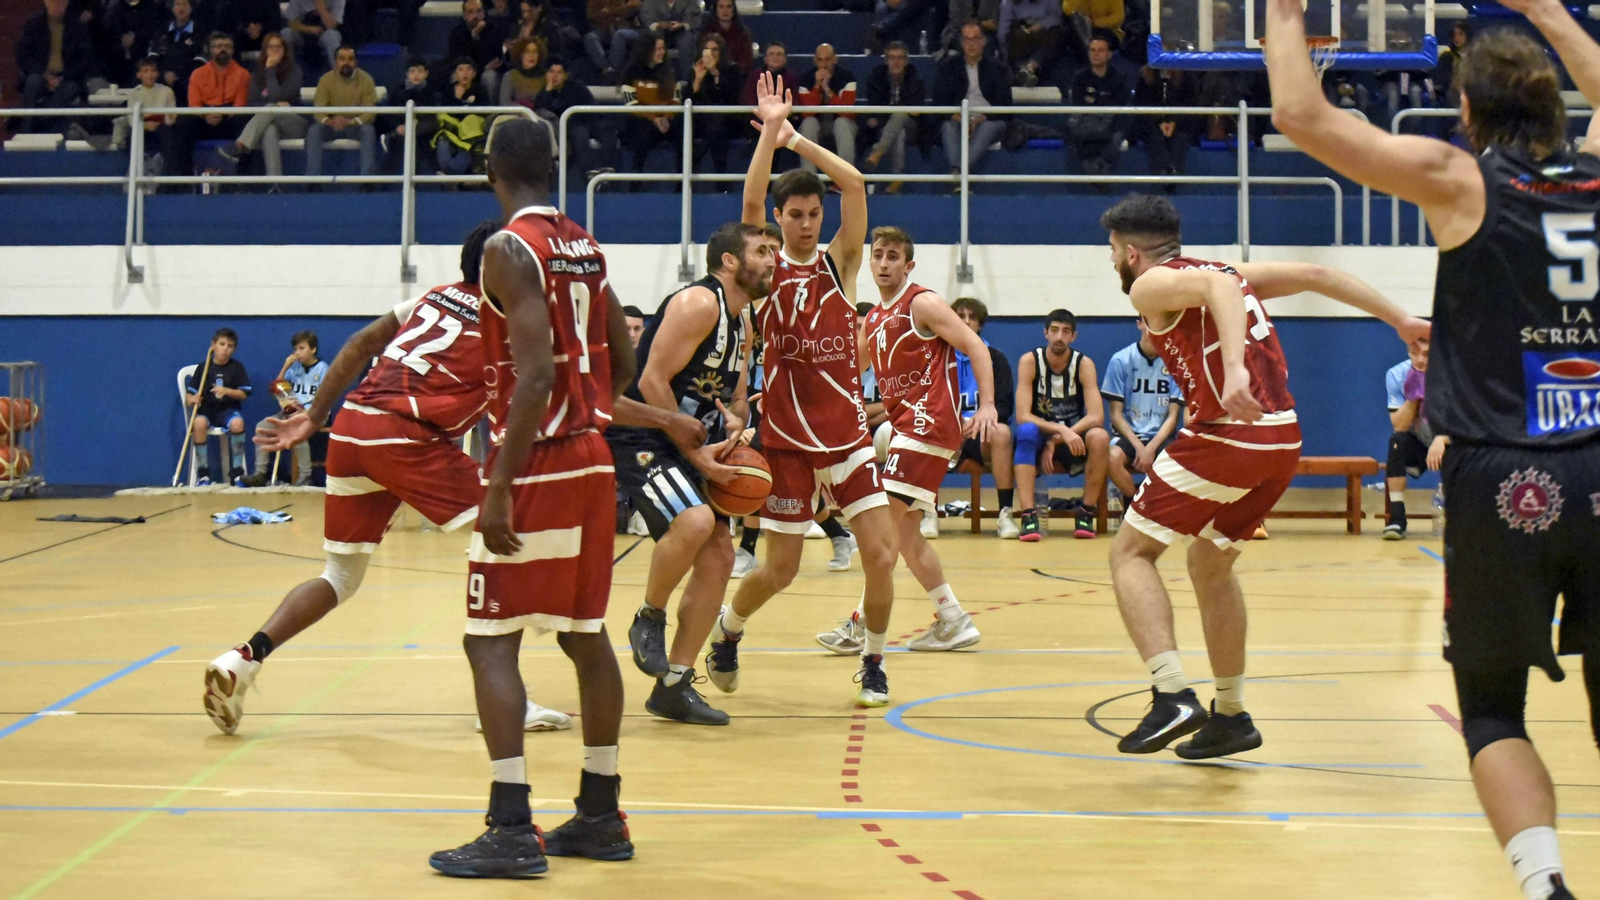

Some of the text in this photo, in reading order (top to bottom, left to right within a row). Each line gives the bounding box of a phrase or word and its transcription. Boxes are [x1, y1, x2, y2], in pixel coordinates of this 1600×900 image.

[1541, 212, 1600, 301] 5
[569, 281, 591, 374] 9
[1562, 304, 1593, 324] LA
[383, 303, 463, 377] 22
[1520, 326, 1600, 344] SERRA
[1157, 396, 1170, 407] 16
[865, 462, 879, 488] 7
[469, 573, 486, 611] 9
